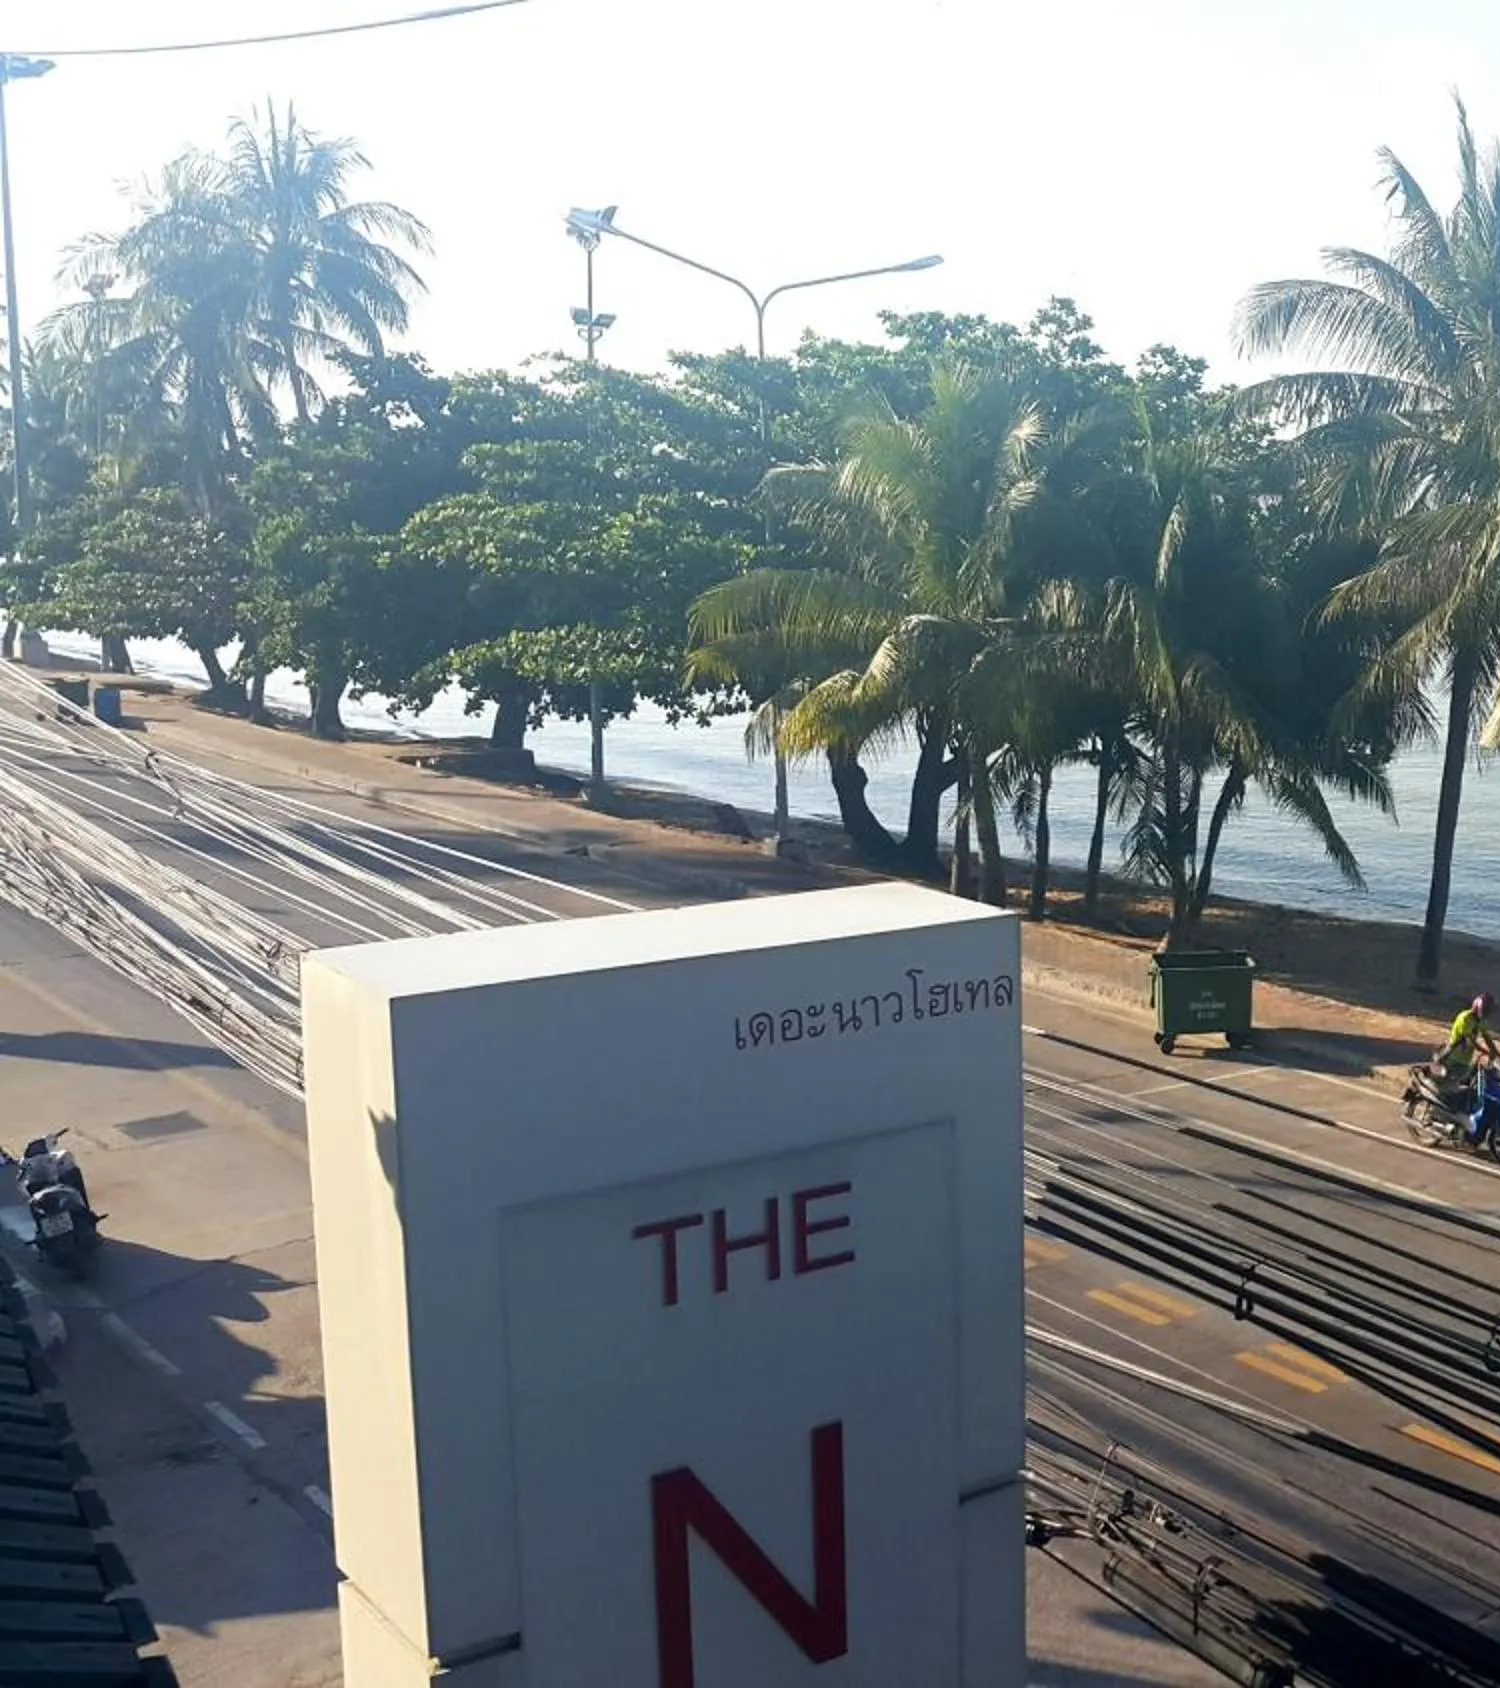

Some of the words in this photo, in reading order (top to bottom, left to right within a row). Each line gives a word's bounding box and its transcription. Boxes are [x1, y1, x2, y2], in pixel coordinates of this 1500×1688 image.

[734, 968, 1014, 1050] เดอะนาวโฮเทล
[631, 1181, 856, 1307] THE
[650, 1419, 848, 1688] N
